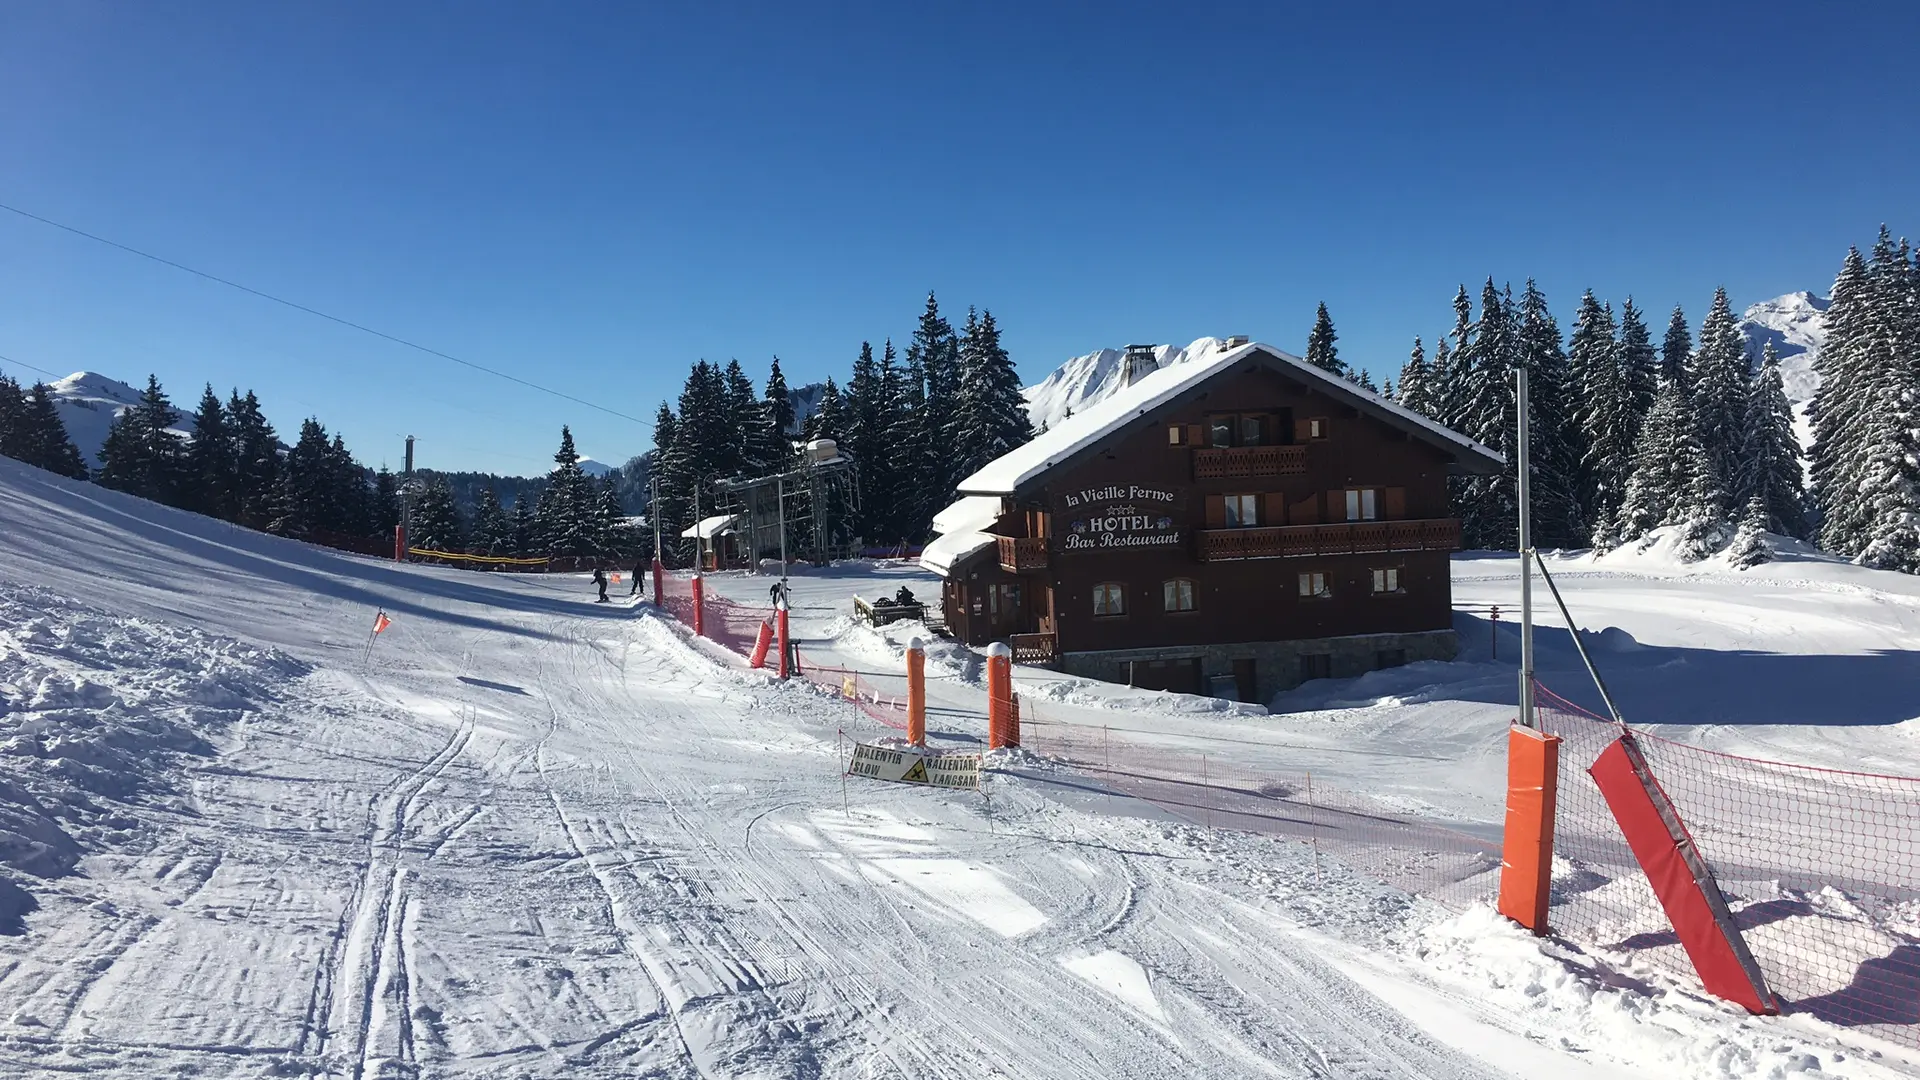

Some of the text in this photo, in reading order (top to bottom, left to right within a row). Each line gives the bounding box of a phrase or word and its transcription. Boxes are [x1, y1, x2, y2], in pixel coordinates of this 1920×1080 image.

[1066, 485, 1174, 507] la Vieille Ferme
[1065, 531, 1180, 549] Bar Restaurant
[856, 746, 903, 765] RALENTIR
[853, 761, 881, 776] SLOW
[925, 758, 978, 771] RALLENTARE
[932, 773, 977, 787] LANGSAM
